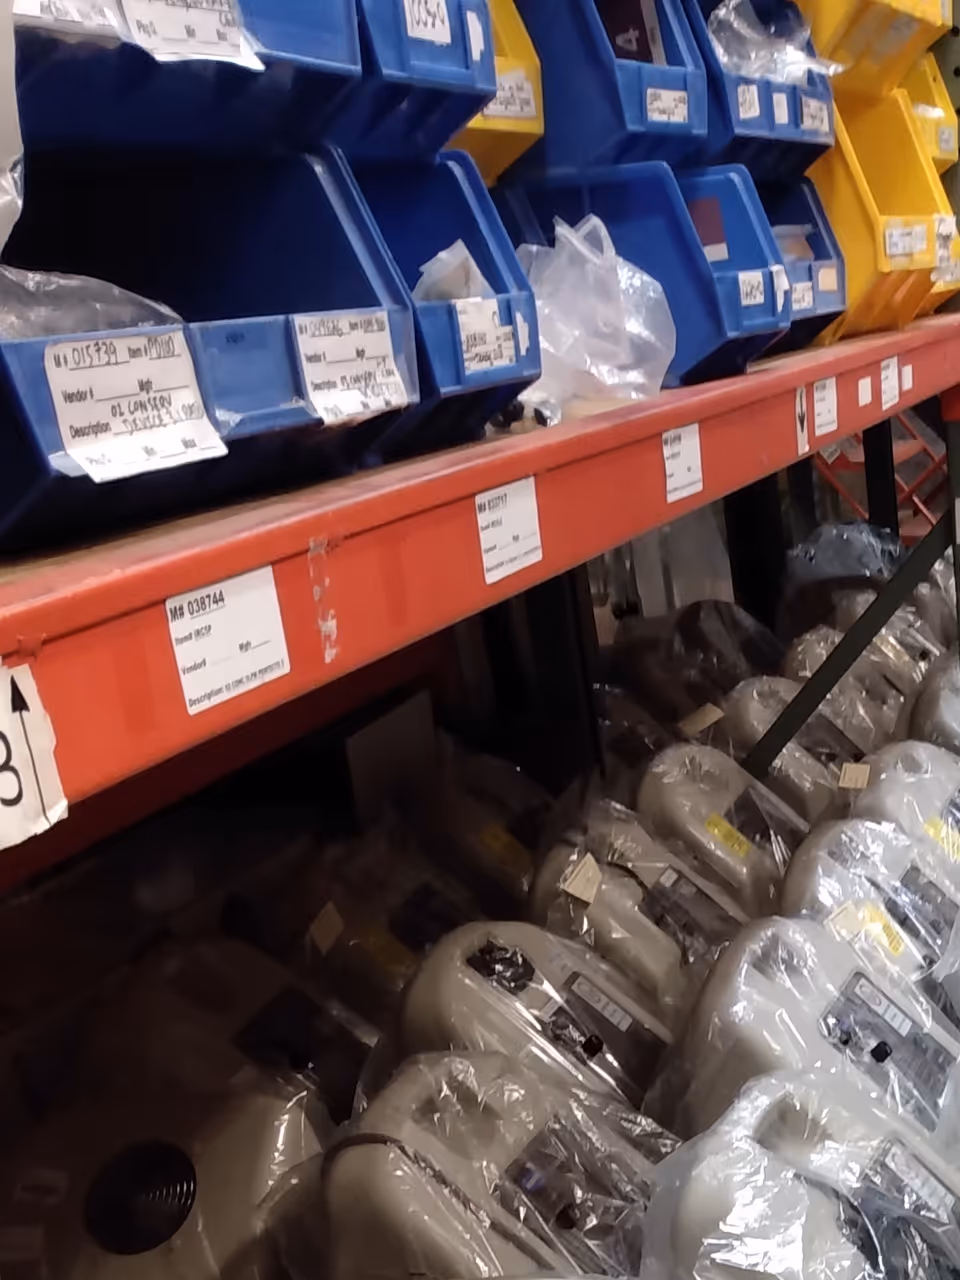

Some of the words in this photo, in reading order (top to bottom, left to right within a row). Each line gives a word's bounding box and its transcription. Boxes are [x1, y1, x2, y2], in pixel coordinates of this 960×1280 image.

[61, 388, 88, 404] Vendor
[69, 420, 112, 439] Description
[169, 603, 184, 622] M#
[187, 589, 225, 616] 038744
